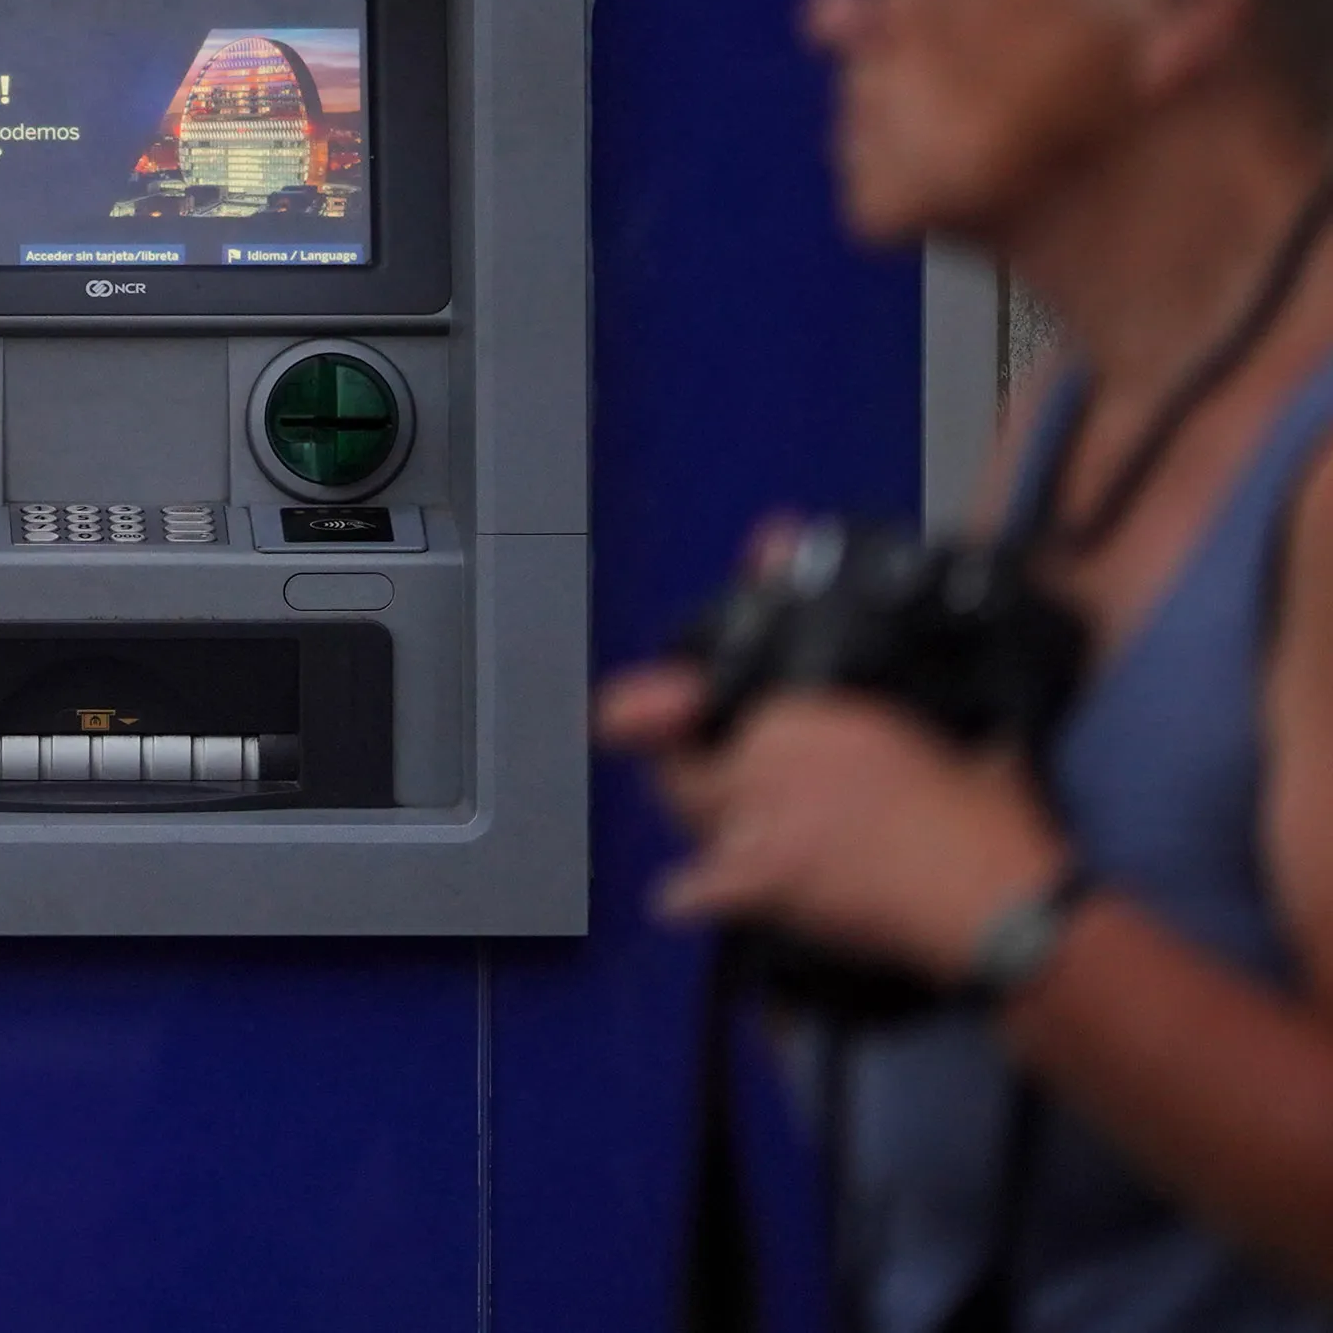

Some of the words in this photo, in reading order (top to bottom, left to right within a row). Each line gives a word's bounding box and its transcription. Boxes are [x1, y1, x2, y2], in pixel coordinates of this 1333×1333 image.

[25, 250, 74, 262] Acceder
[75, 250, 93, 262] sin
[95, 250, 179, 263] tarjeta/libreta
[247, 250, 287, 262] Idioma
[300, 250, 358, 264] Language
[114, 283, 146, 294] NCR
